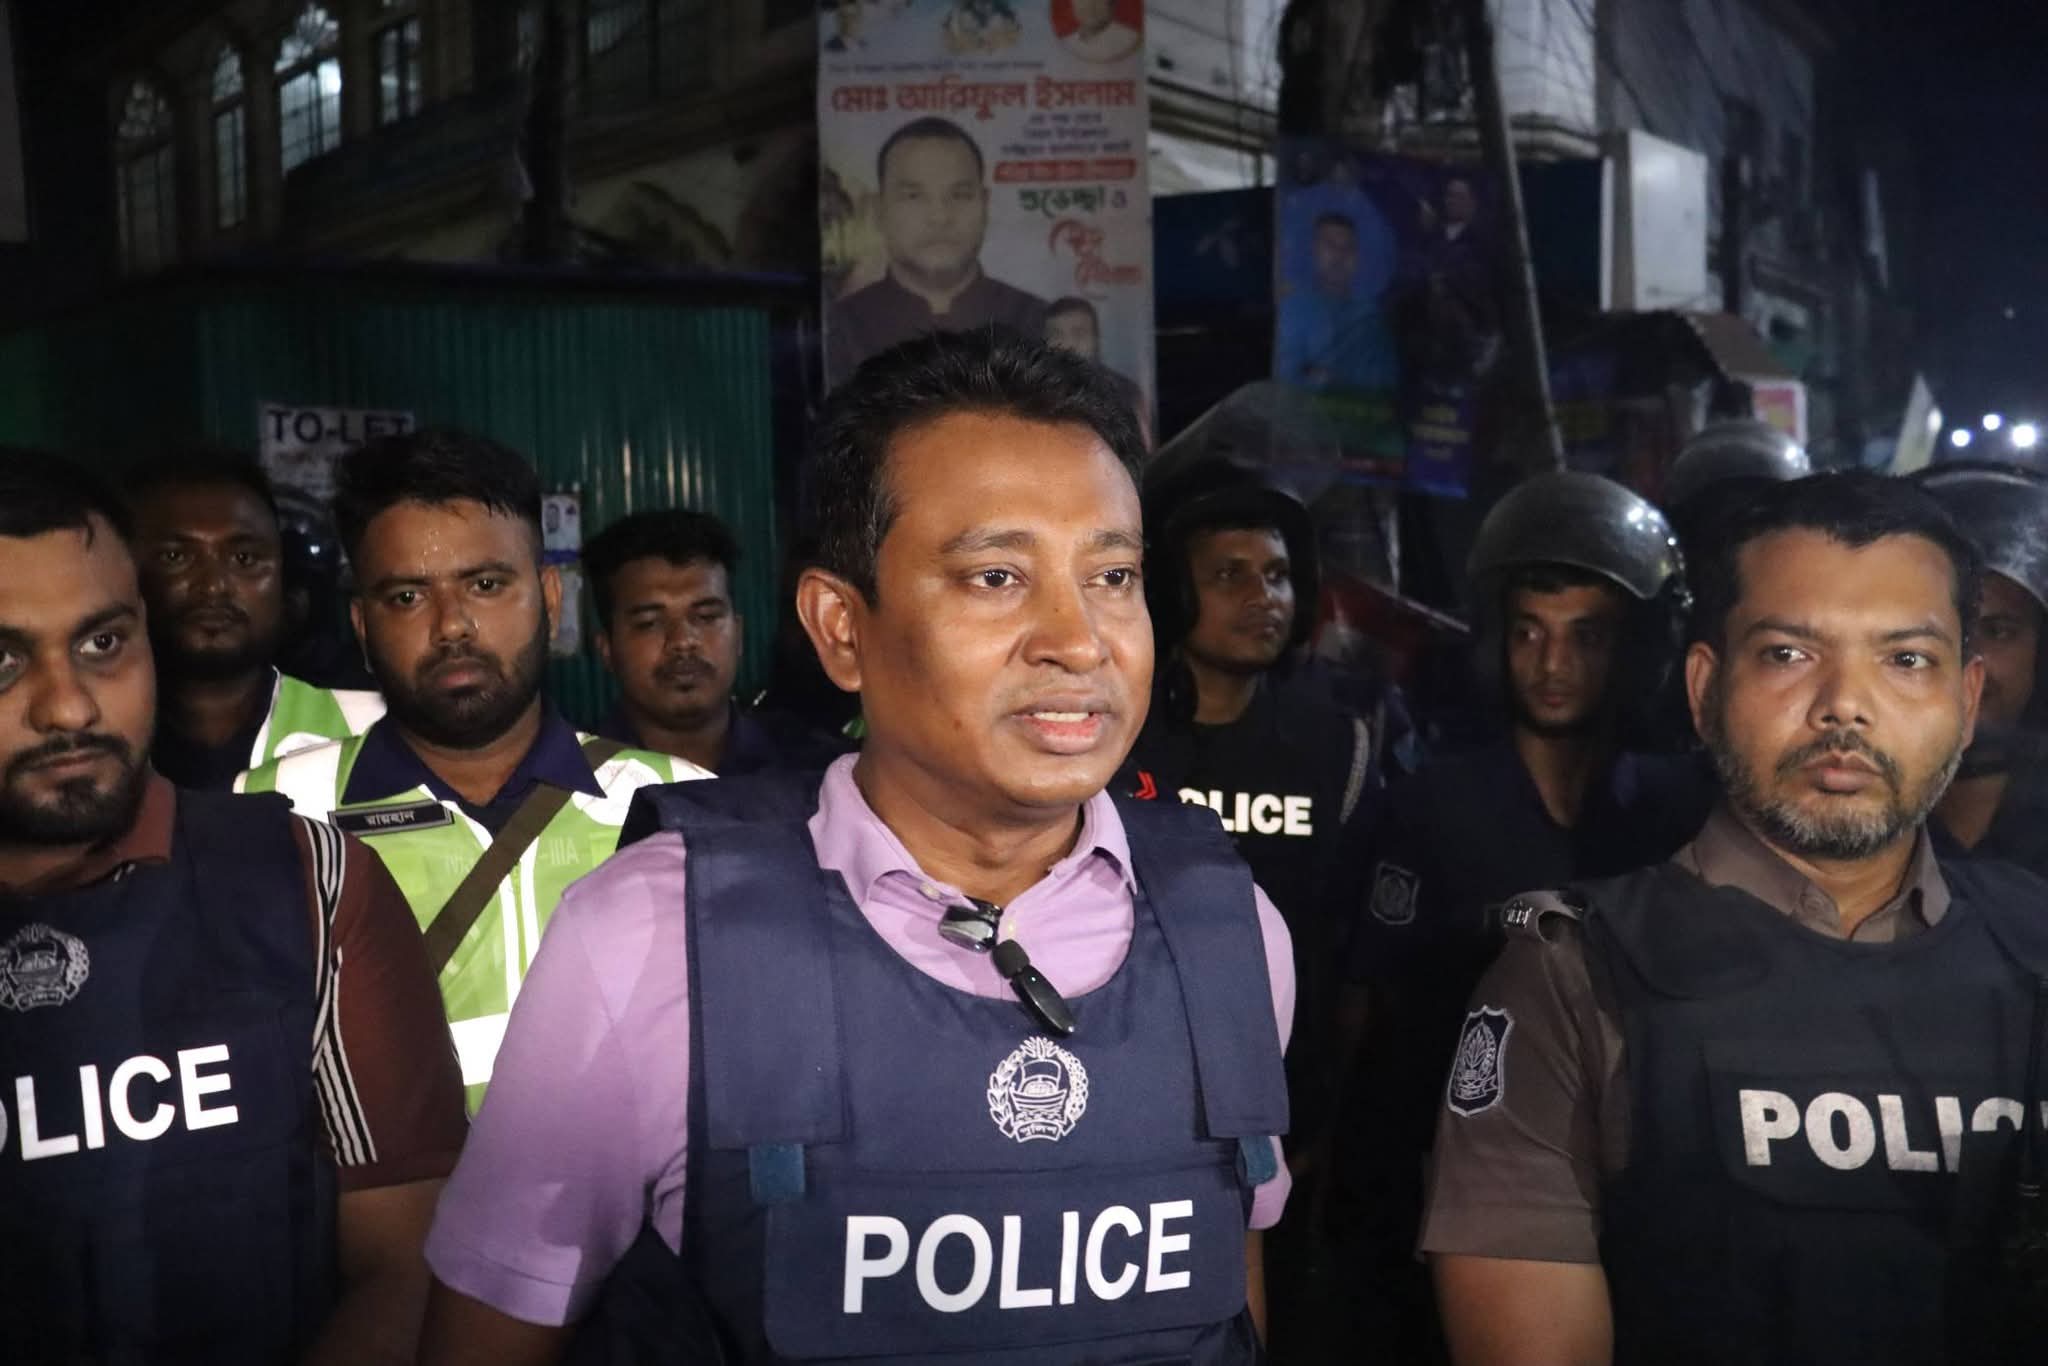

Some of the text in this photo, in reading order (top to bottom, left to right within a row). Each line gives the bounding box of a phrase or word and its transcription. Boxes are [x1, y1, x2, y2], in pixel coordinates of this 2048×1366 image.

[1035, 76, 1137, 108] ইসলাম
[268, 410, 411, 444] TO-LET
[0, 1044, 239, 1161] LICE
[1739, 1088, 2048, 1173] POLI
[843, 1199, 1193, 1313] POLICE
